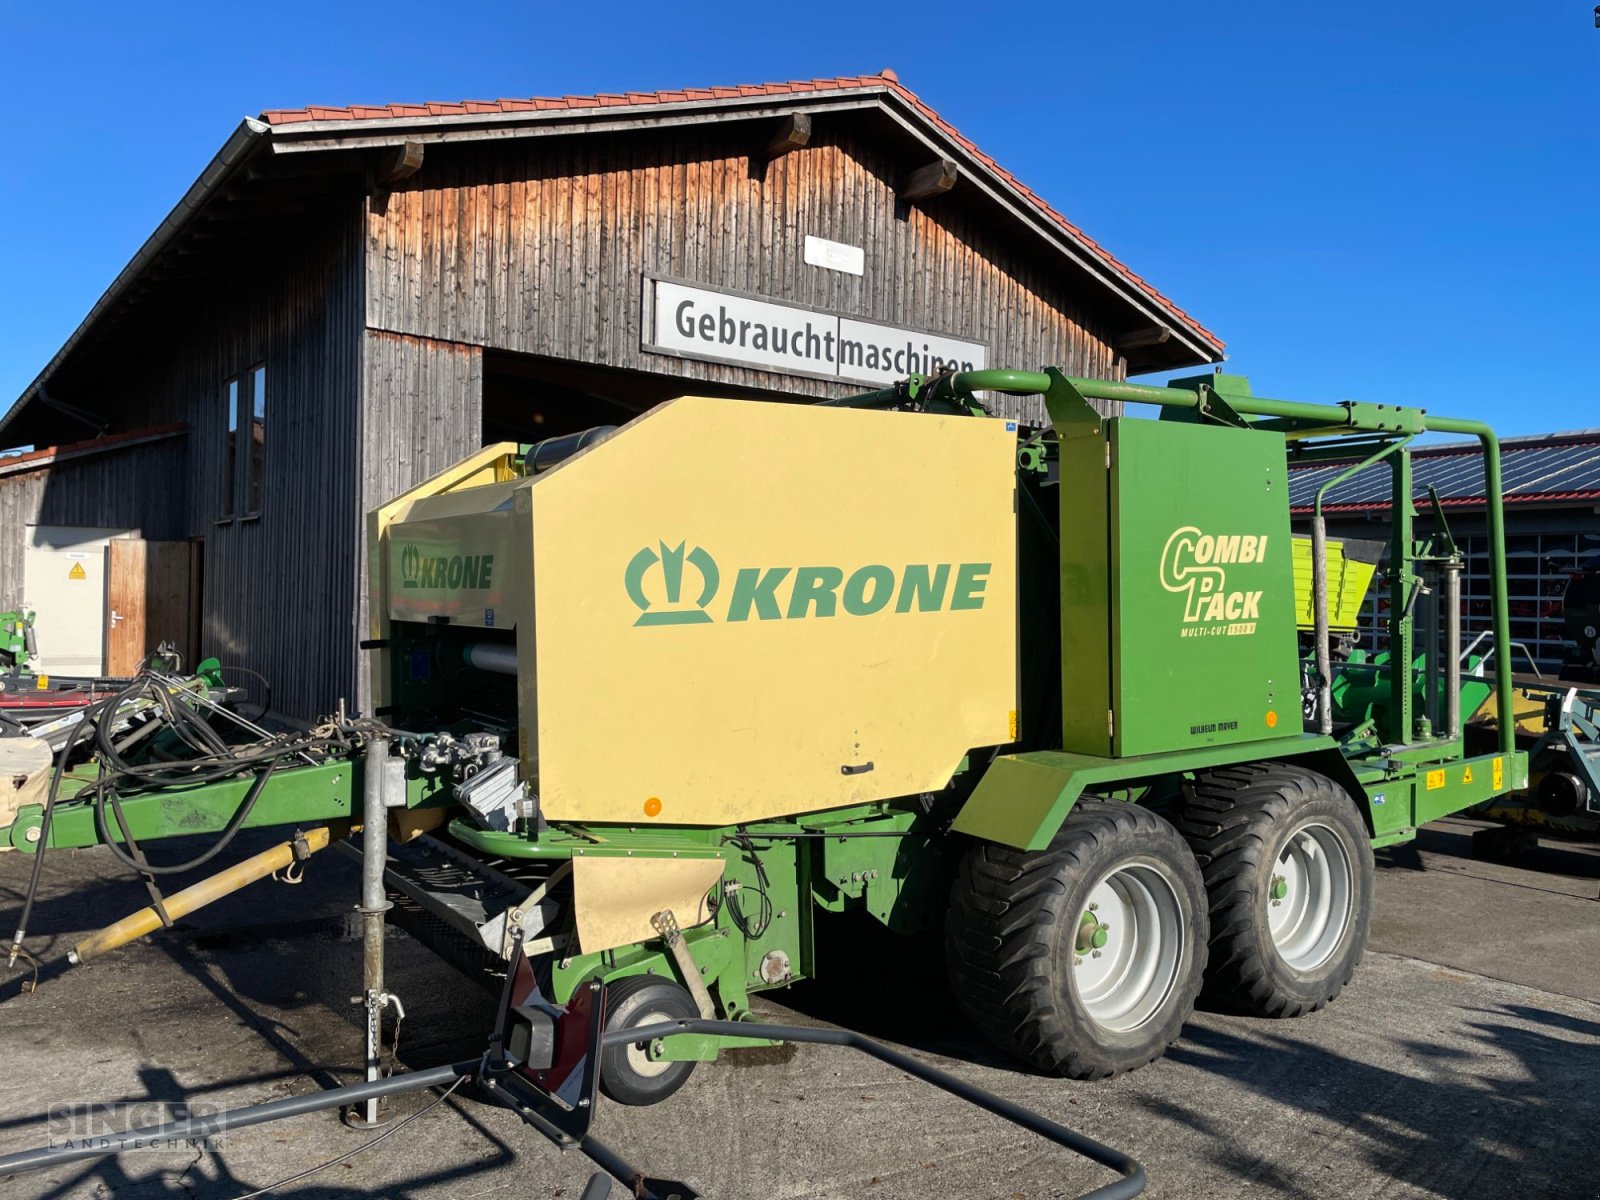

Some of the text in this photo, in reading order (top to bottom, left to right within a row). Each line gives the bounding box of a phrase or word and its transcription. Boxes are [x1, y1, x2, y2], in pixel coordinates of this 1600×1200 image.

[421, 555, 494, 590] KRONE
[1160, 526, 1268, 592] COMBI
[726, 562, 992, 622] KRONE
[1183, 567, 1263, 622] PACK
[1181, 626, 1227, 637] MULTI-CUT
[1190, 723, 1217, 735] WILHELM
